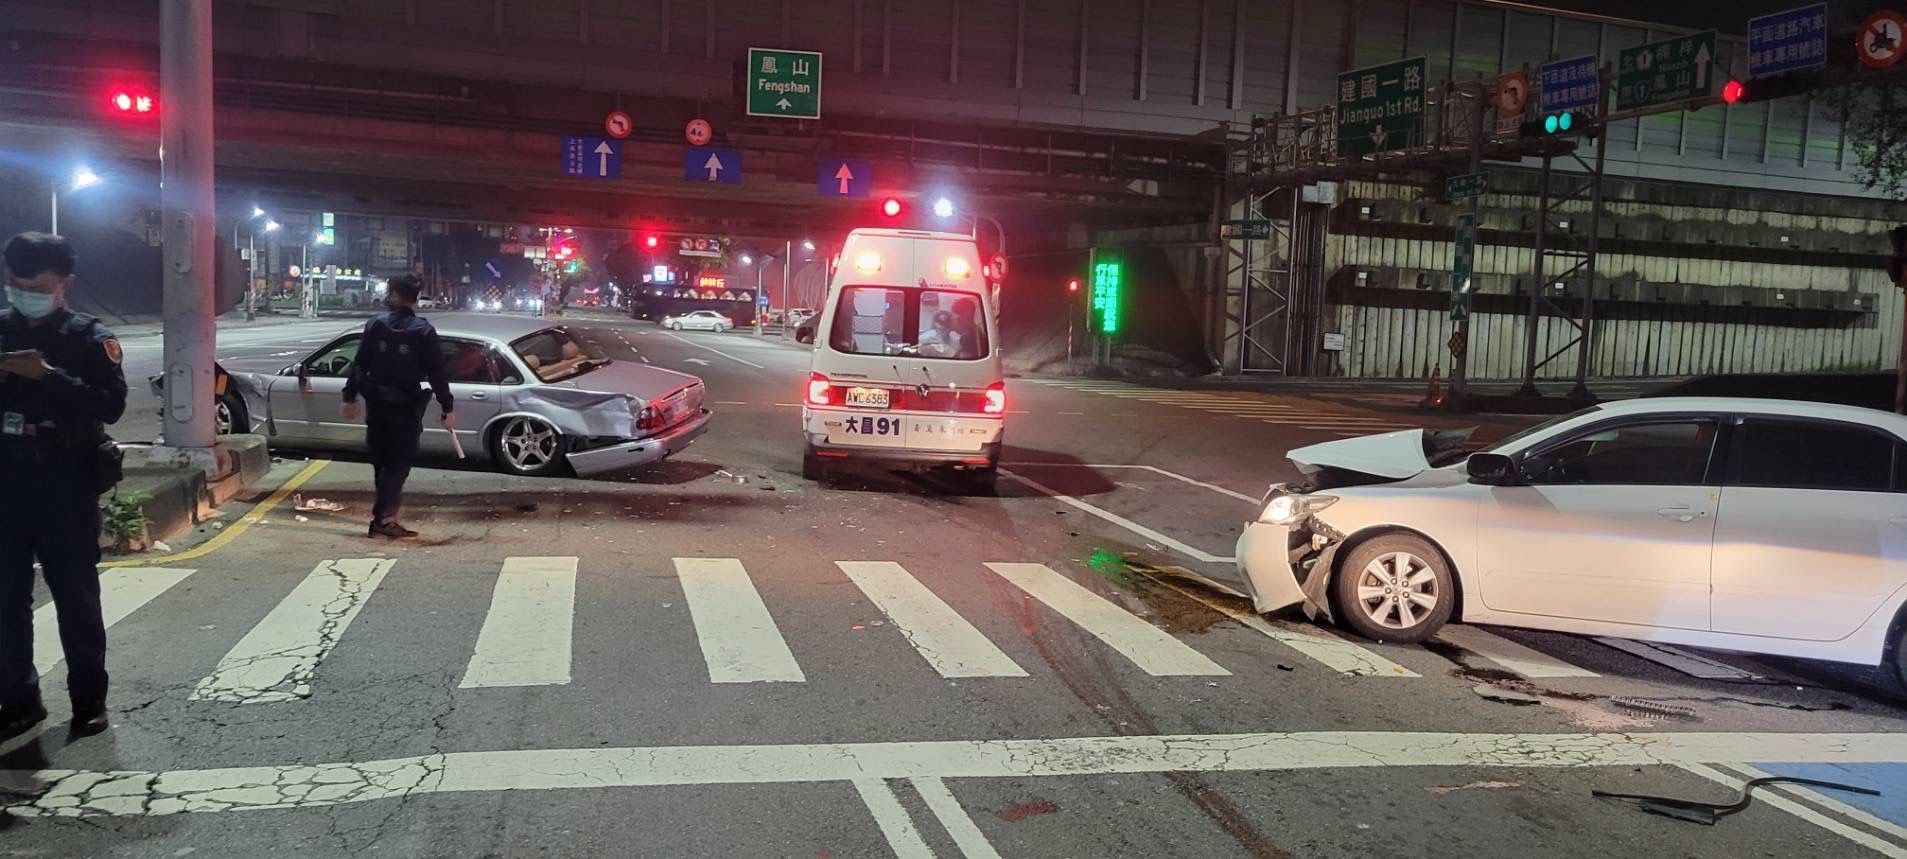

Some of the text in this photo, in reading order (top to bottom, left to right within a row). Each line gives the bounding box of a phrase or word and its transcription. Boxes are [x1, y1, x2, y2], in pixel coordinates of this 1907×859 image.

[761, 56, 809, 76] 鳳山
[758, 79, 810, 95] Fengshan
[1340, 64, 1421, 103] 建國一路
[1339, 96, 1422, 125] Jianguo 1st Rd.
